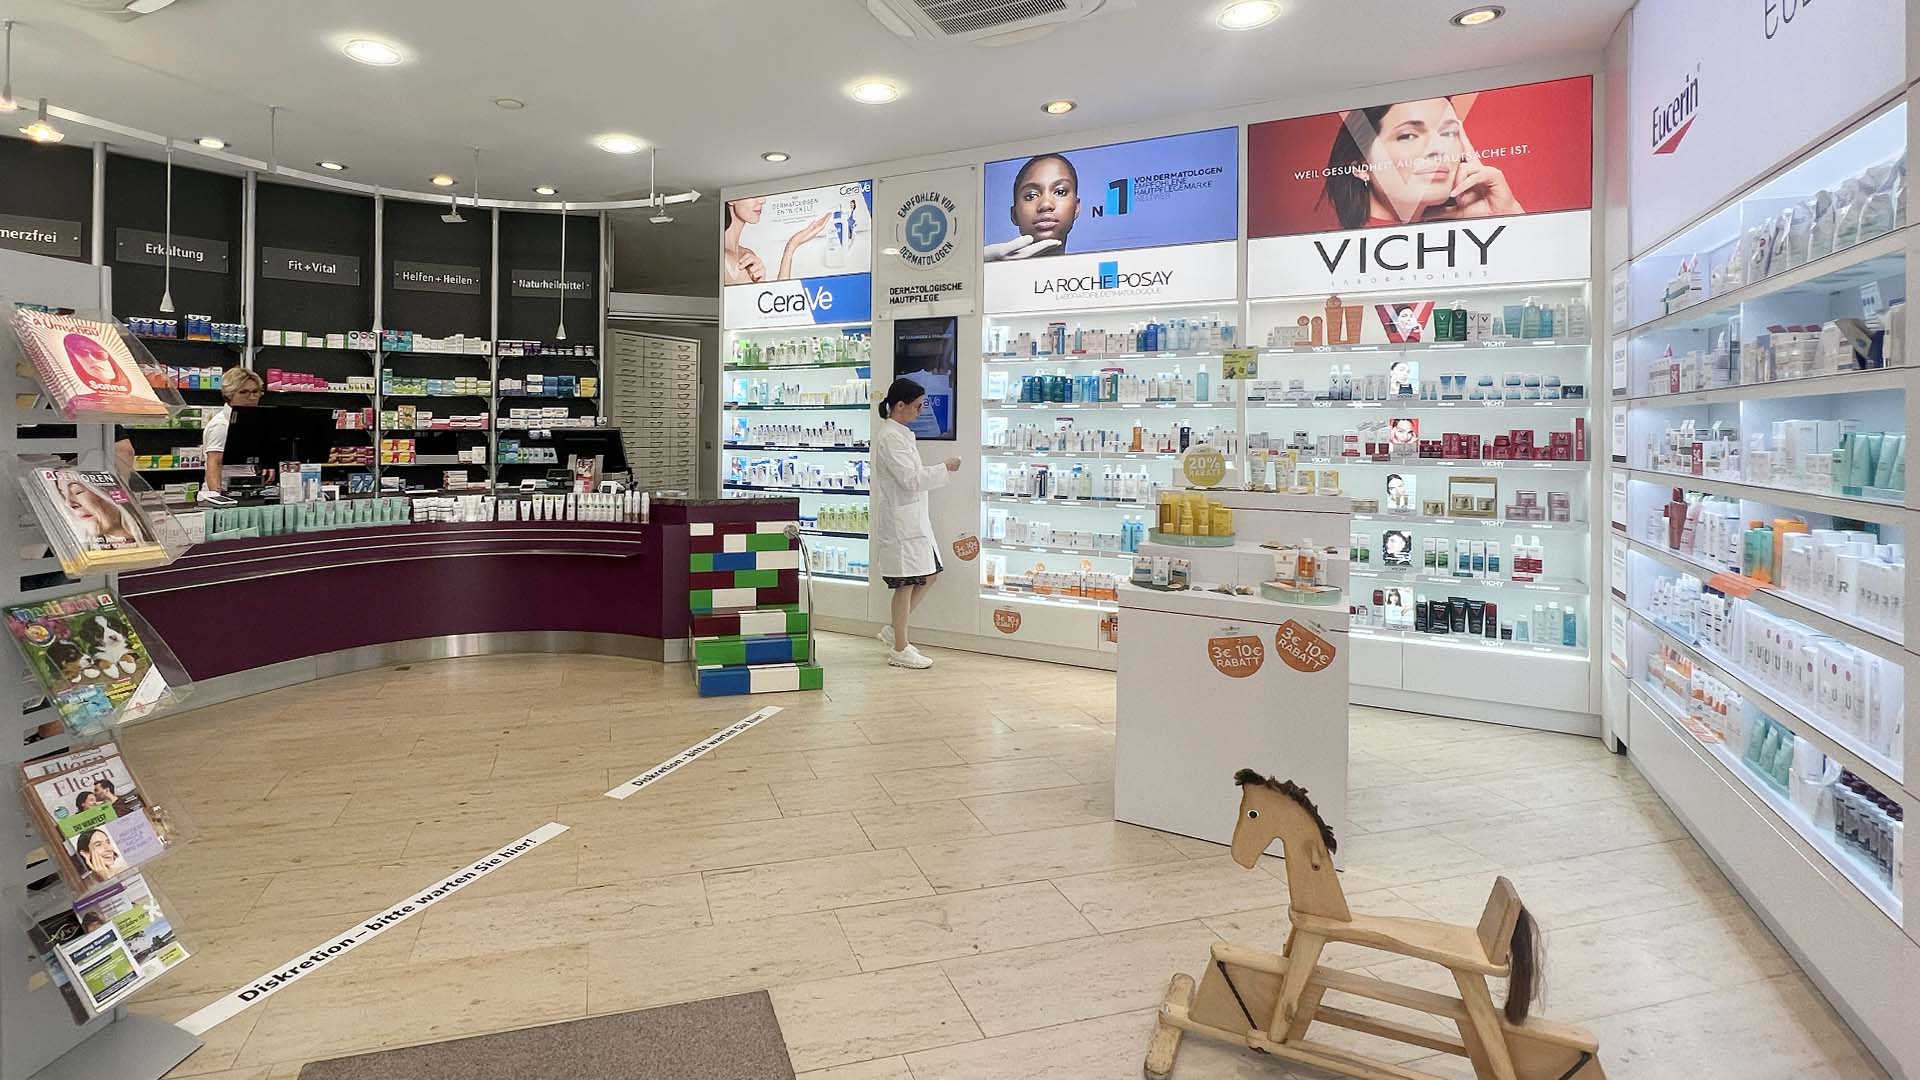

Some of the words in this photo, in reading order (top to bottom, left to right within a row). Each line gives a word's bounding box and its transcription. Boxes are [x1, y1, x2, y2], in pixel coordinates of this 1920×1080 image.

[1652, 73, 1698, 147] Eucerin
[1294, 170, 1319, 180] WEIL
[1434, 147, 1506, 163] HAUTSACHE
[1511, 144, 1531, 155] IST.
[1134, 175, 1152, 183] VON
[1153, 167, 1223, 181] DERMATOLOGEN
[839, 184, 871, 195] CeraVe
[898, 192, 940, 218] EMPFOHLEN
[941, 196, 956, 213] VON
[899, 241, 955, 266] DERMATOLOGEN
[1314, 225, 1506, 275] VICHY
[402, 271, 434, 283] Helfen
[443, 274, 473, 285] Heilen
[1034, 279, 1054, 294] LA
[1056, 274, 1113, 293] ROCHE
[1117, 270, 1174, 289] POSAY
[889, 282, 963, 296] DERMATOLOGISCHE
[889, 294, 940, 304] HAUTPFLEGE
[757, 286, 833, 314] CeraVe
[1189, 456, 1220, 470] 20%
[1281, 627, 1302, 646] 3€
[1212, 646, 1232, 658] 3€
[1236, 645, 1262, 657] 10€
[1217, 656, 1260, 668] RABATT
[1278, 638, 1322, 669] RABATT
[237, 938, 355, 1002] Diskretion
[365, 904, 415, 932] bitte
[415, 871, 476, 906] warten
[474, 855, 502, 873] Sie
[499, 837, 537, 859] hier!
